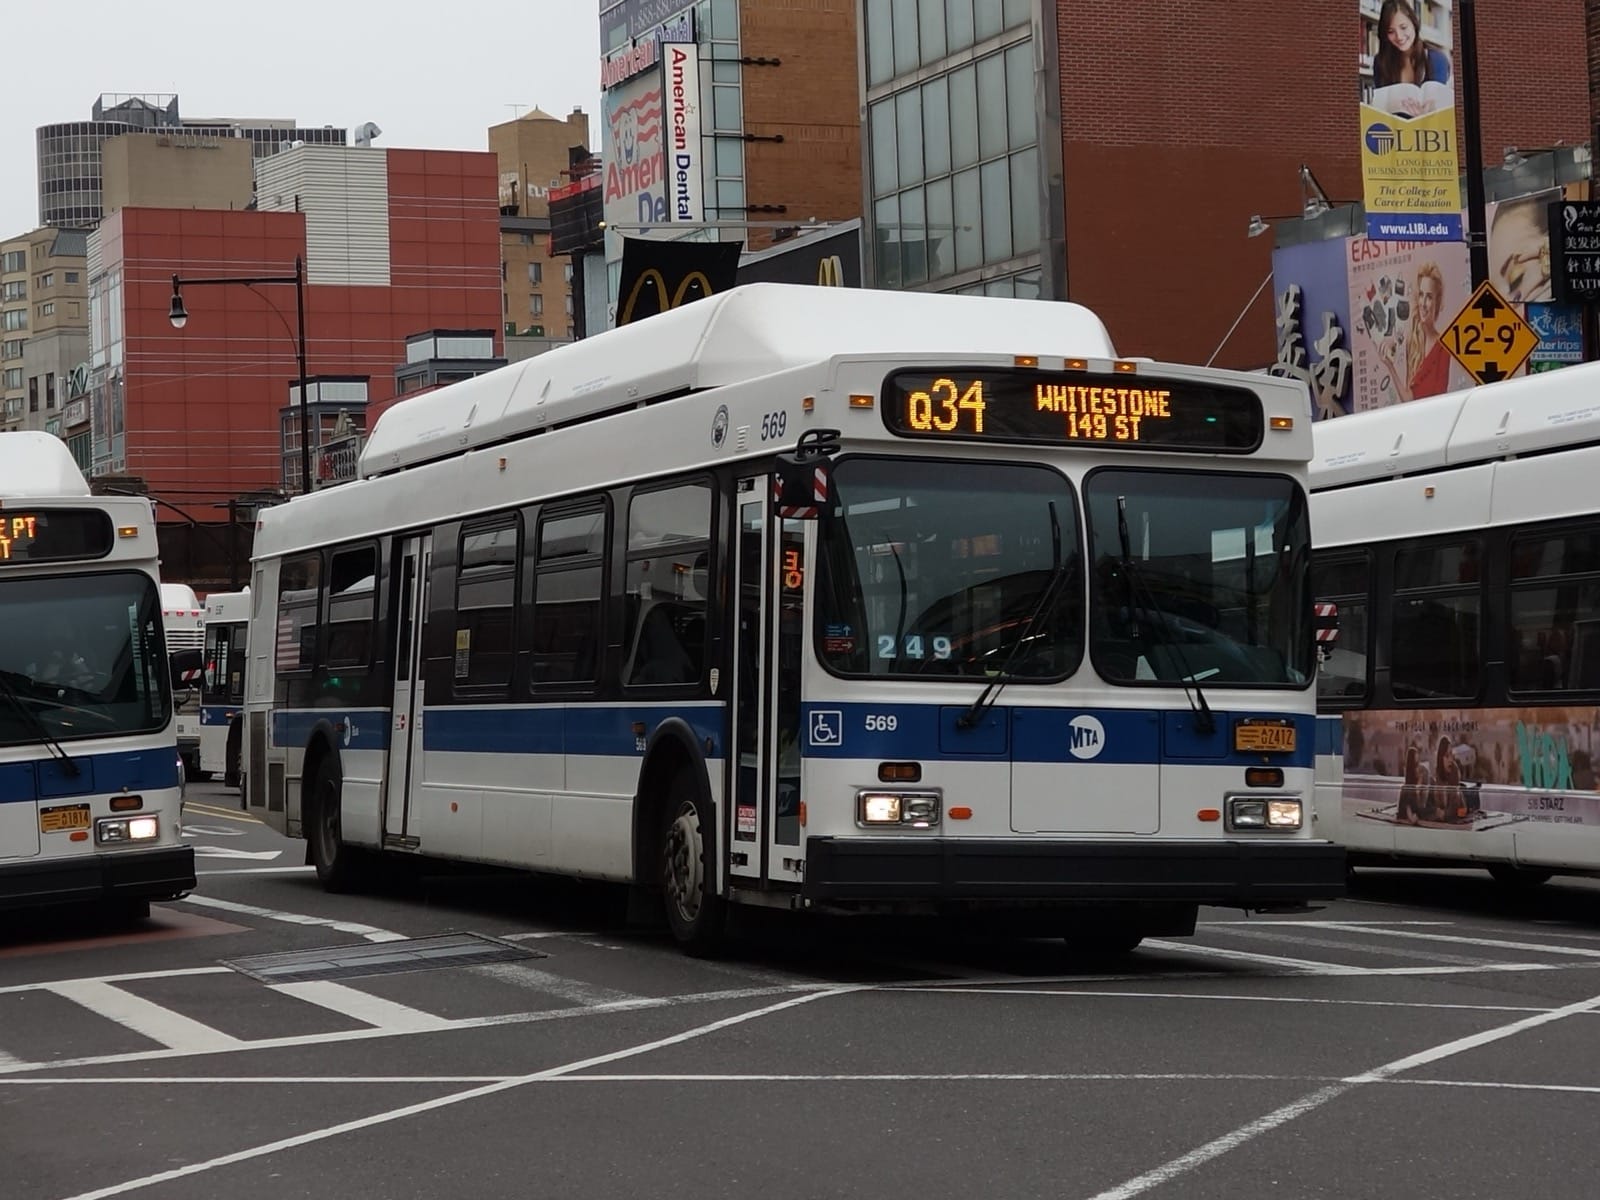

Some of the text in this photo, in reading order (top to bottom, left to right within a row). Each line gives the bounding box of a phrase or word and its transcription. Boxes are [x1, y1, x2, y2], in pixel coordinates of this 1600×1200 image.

[671, 48, 692, 220] American Dental
[1395, 129, 1451, 153] LIBI
[1374, 198, 1452, 208] Career Education
[1380, 186, 1448, 198] The College for
[1380, 223, 1449, 235] www.LIBI.edu
[1453, 322, 1521, 355] 12'-9"
[909, 378, 1171, 433] Q34 WHITESTONE
[761, 410, 787, 442] 569
[1068, 413, 1141, 440] 149 ST
[13, 517, 35, 538] PT
[865, 715, 898, 731] 569
[1539, 798, 1564, 810] STARZ
